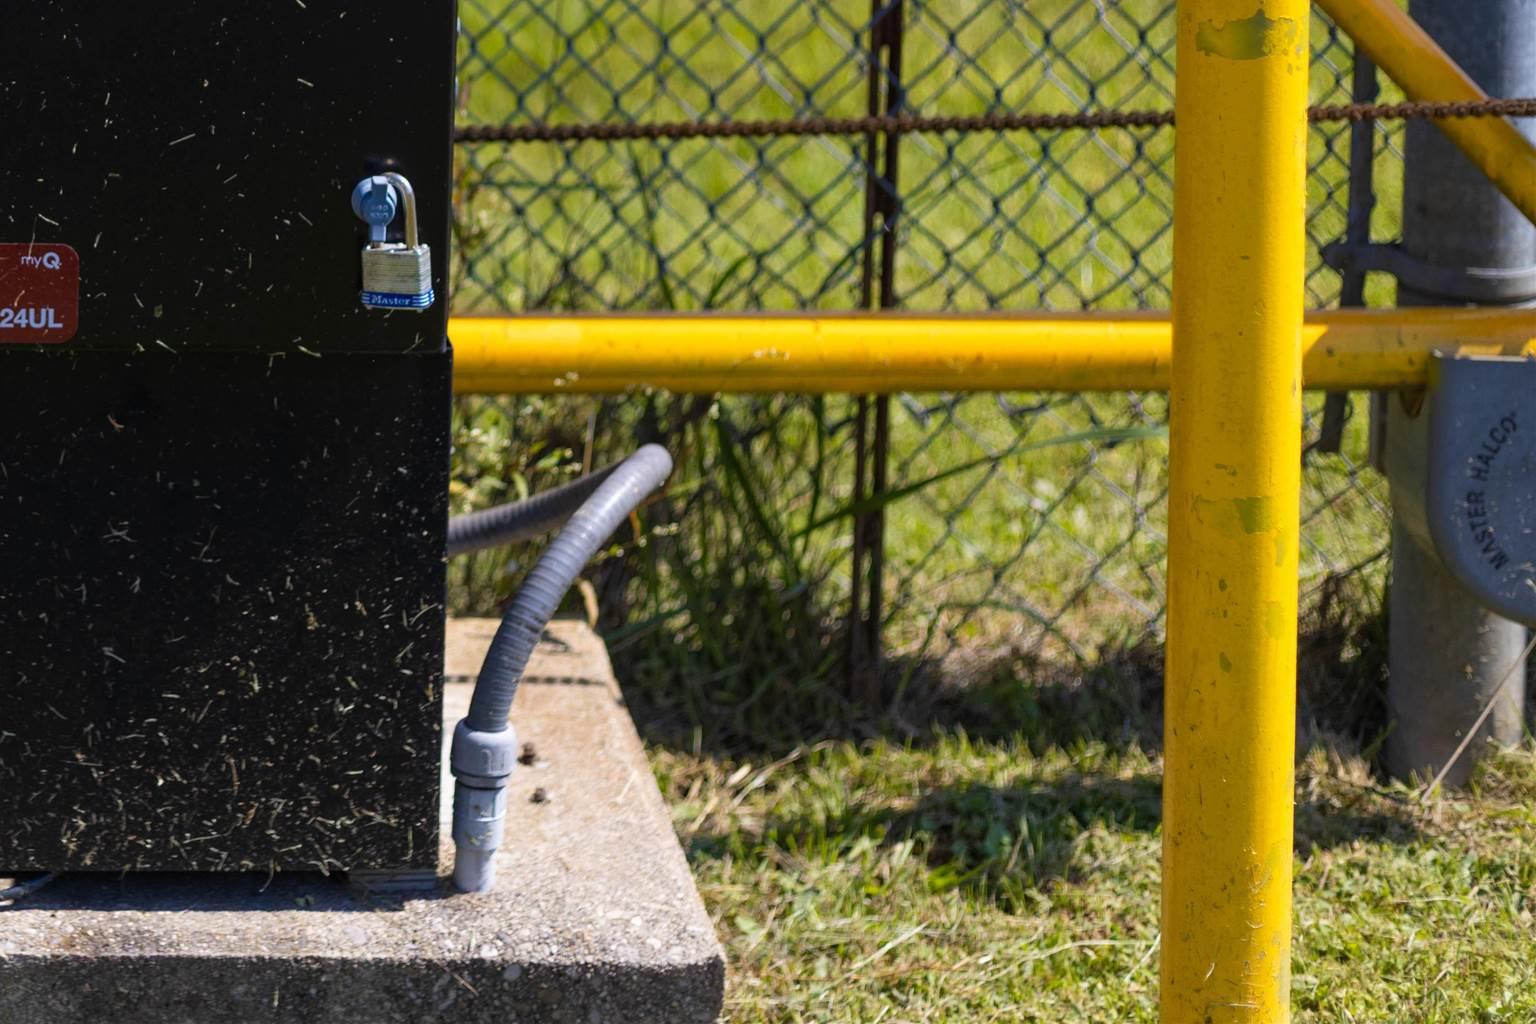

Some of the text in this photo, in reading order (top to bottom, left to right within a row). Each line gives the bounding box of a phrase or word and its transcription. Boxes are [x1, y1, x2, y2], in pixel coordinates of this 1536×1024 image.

[20, 251, 62, 270] myQ
[371, 294, 411, 305] Master
[1465, 416, 1518, 572] MASTER HALCO
